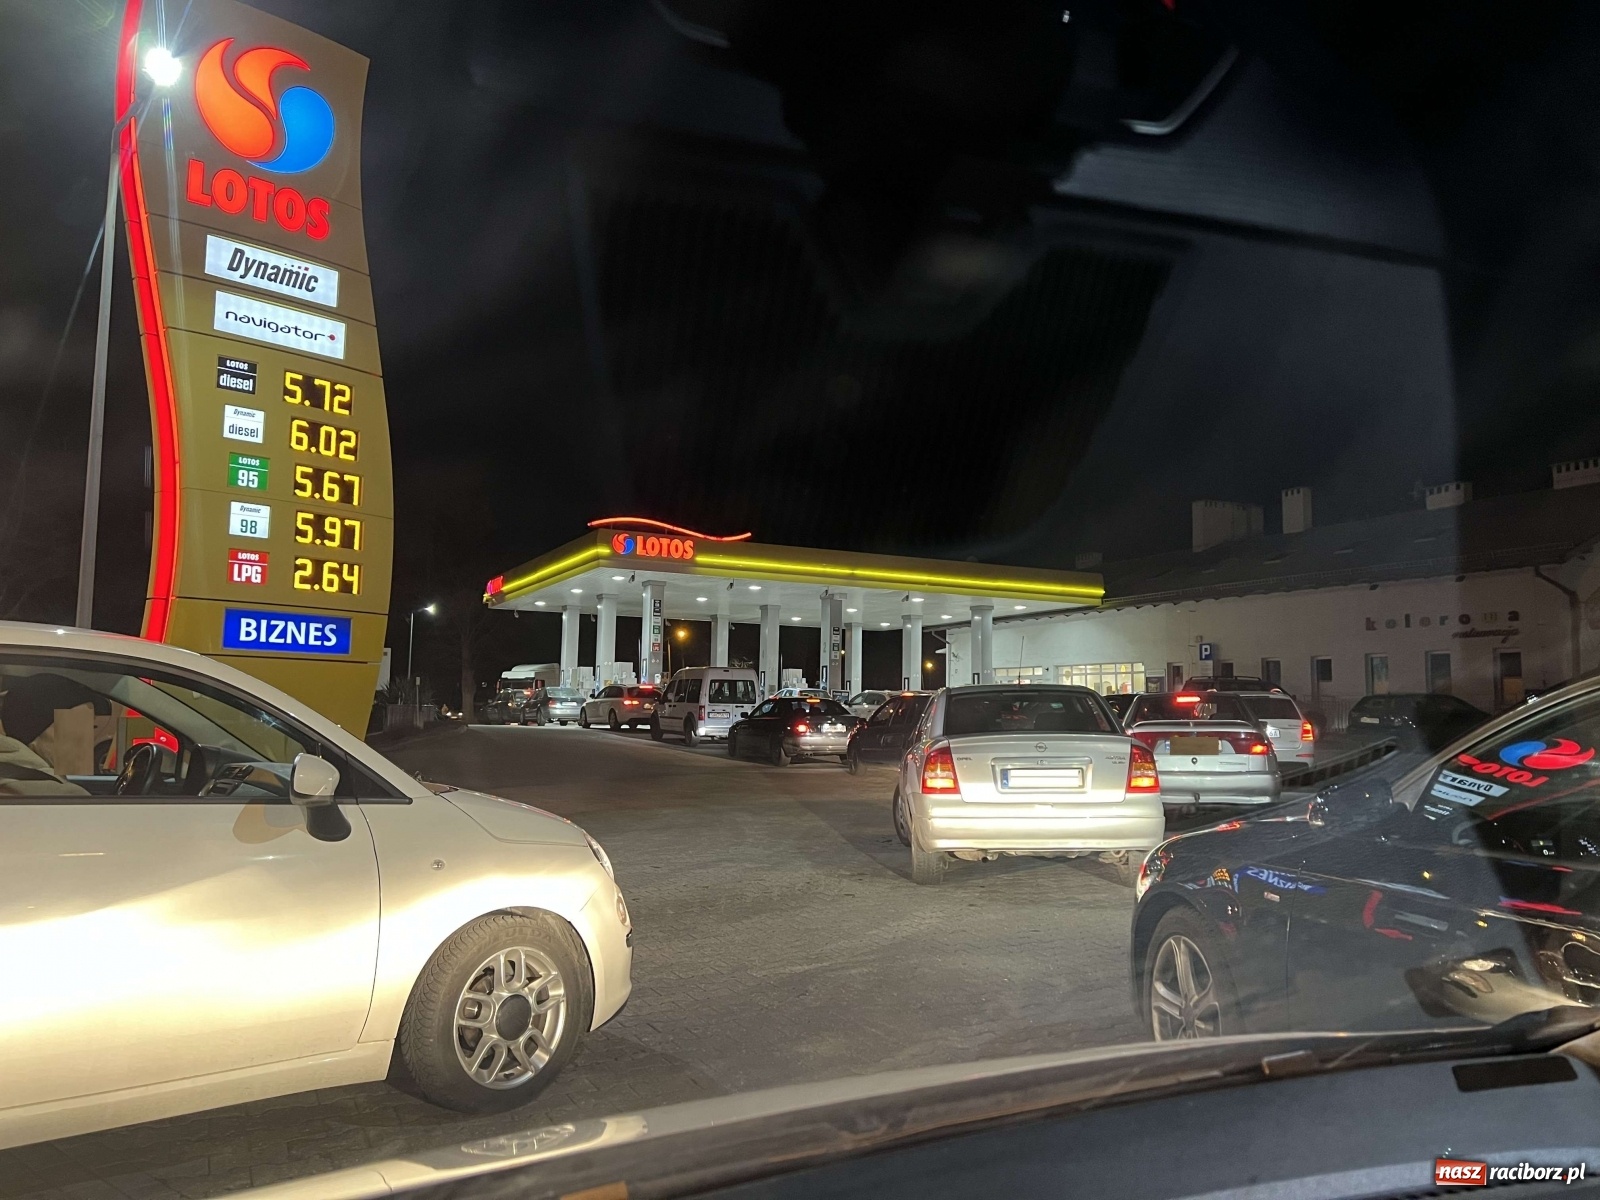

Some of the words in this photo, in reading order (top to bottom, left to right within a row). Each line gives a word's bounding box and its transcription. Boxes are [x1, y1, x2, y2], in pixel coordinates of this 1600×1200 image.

[186, 159, 330, 241] LOTOS
[227, 247, 319, 293] Dynamic
[225, 310, 327, 341] navigator
[226, 359, 249, 371] LOTOS
[219, 373, 254, 391] diesel
[284, 371, 351, 416] 5.72
[233, 408, 256, 418] Dynamic
[228, 423, 259, 438] diesel
[290, 419, 357, 462] 6.02
[238, 456, 260, 467] LOTOS
[237, 469, 259, 488] 95
[294, 465, 360, 506] 5.67
[239, 505, 262, 514] Dynamic
[240, 519, 258, 535] 98
[295, 511, 361, 551] 5.97
[237, 552, 259, 561] LOTOS
[636, 535, 694, 560] LOTOS
[233, 563, 262, 584] LPG
[294, 557, 359, 595] 2.64
[239, 617, 337, 646] BIZNES
[1201, 645, 1211, 659] P
